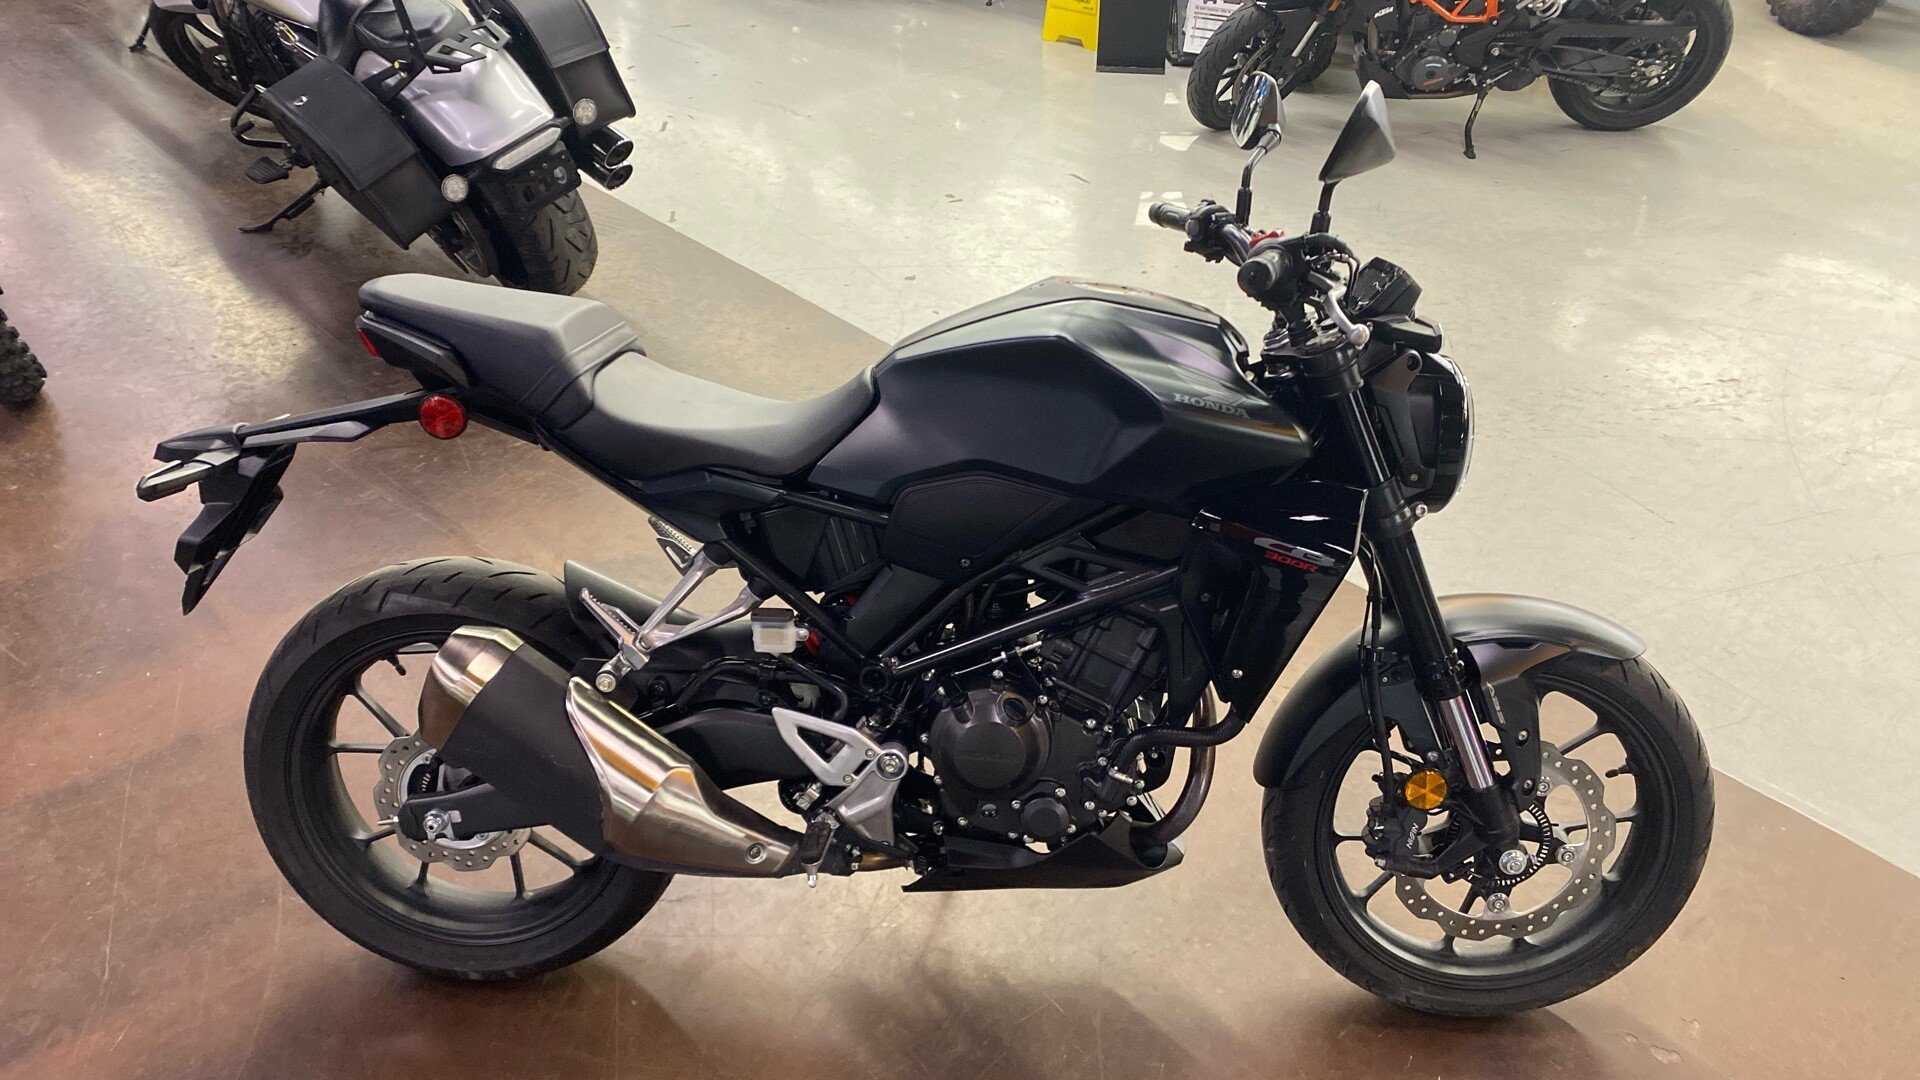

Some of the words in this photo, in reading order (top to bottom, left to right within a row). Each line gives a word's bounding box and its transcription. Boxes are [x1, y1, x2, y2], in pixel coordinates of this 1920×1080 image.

[1173, 393, 1250, 419] HONDA
[1254, 537, 1334, 566] CB
[1264, 551, 1317, 573] 300R
